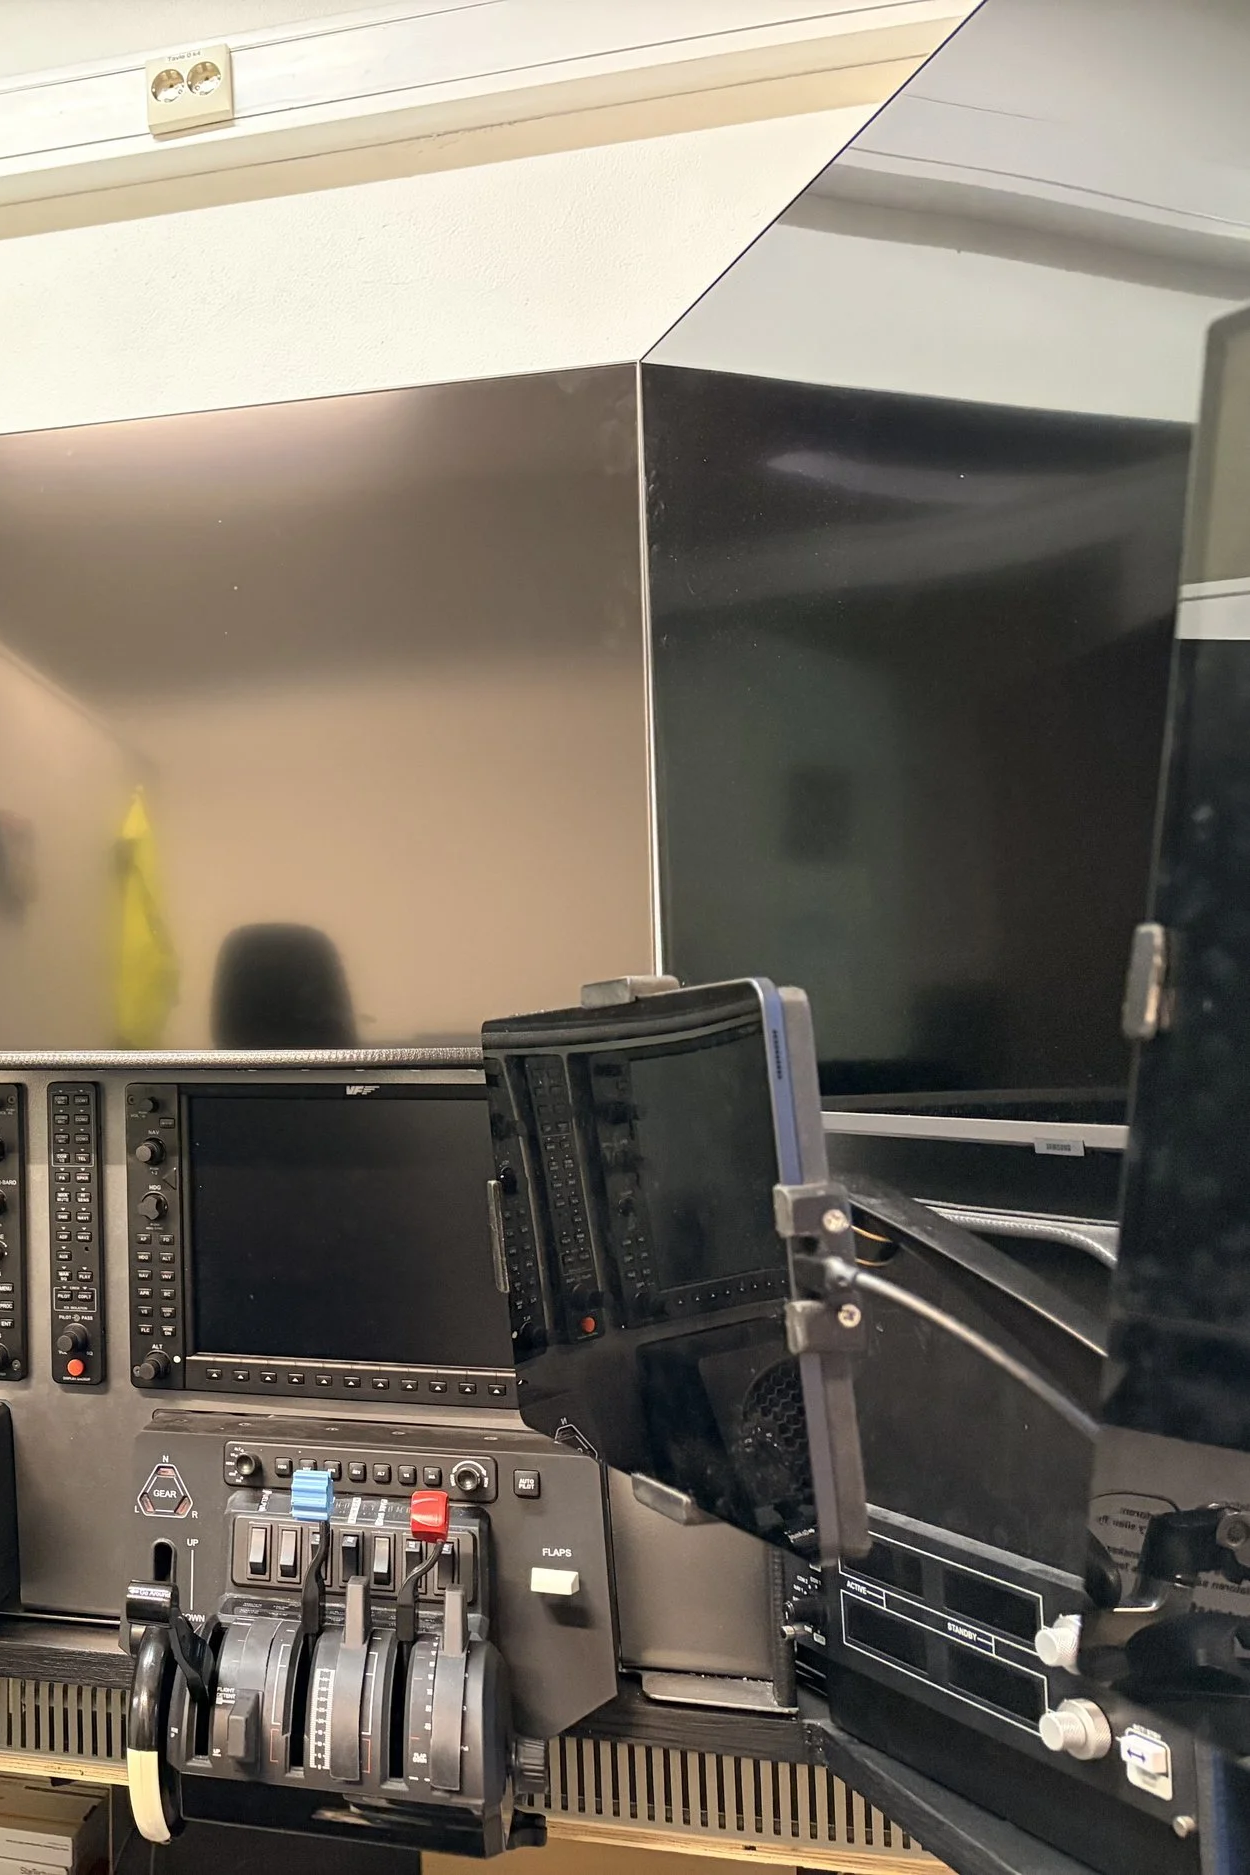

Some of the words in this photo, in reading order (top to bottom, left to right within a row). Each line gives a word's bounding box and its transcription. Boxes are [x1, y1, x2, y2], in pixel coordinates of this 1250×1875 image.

[542, 1548, 572, 1558] FLAPS
[847, 1581, 867, 1595] ACTIVE
[947, 1622, 978, 1641] STANDBY
